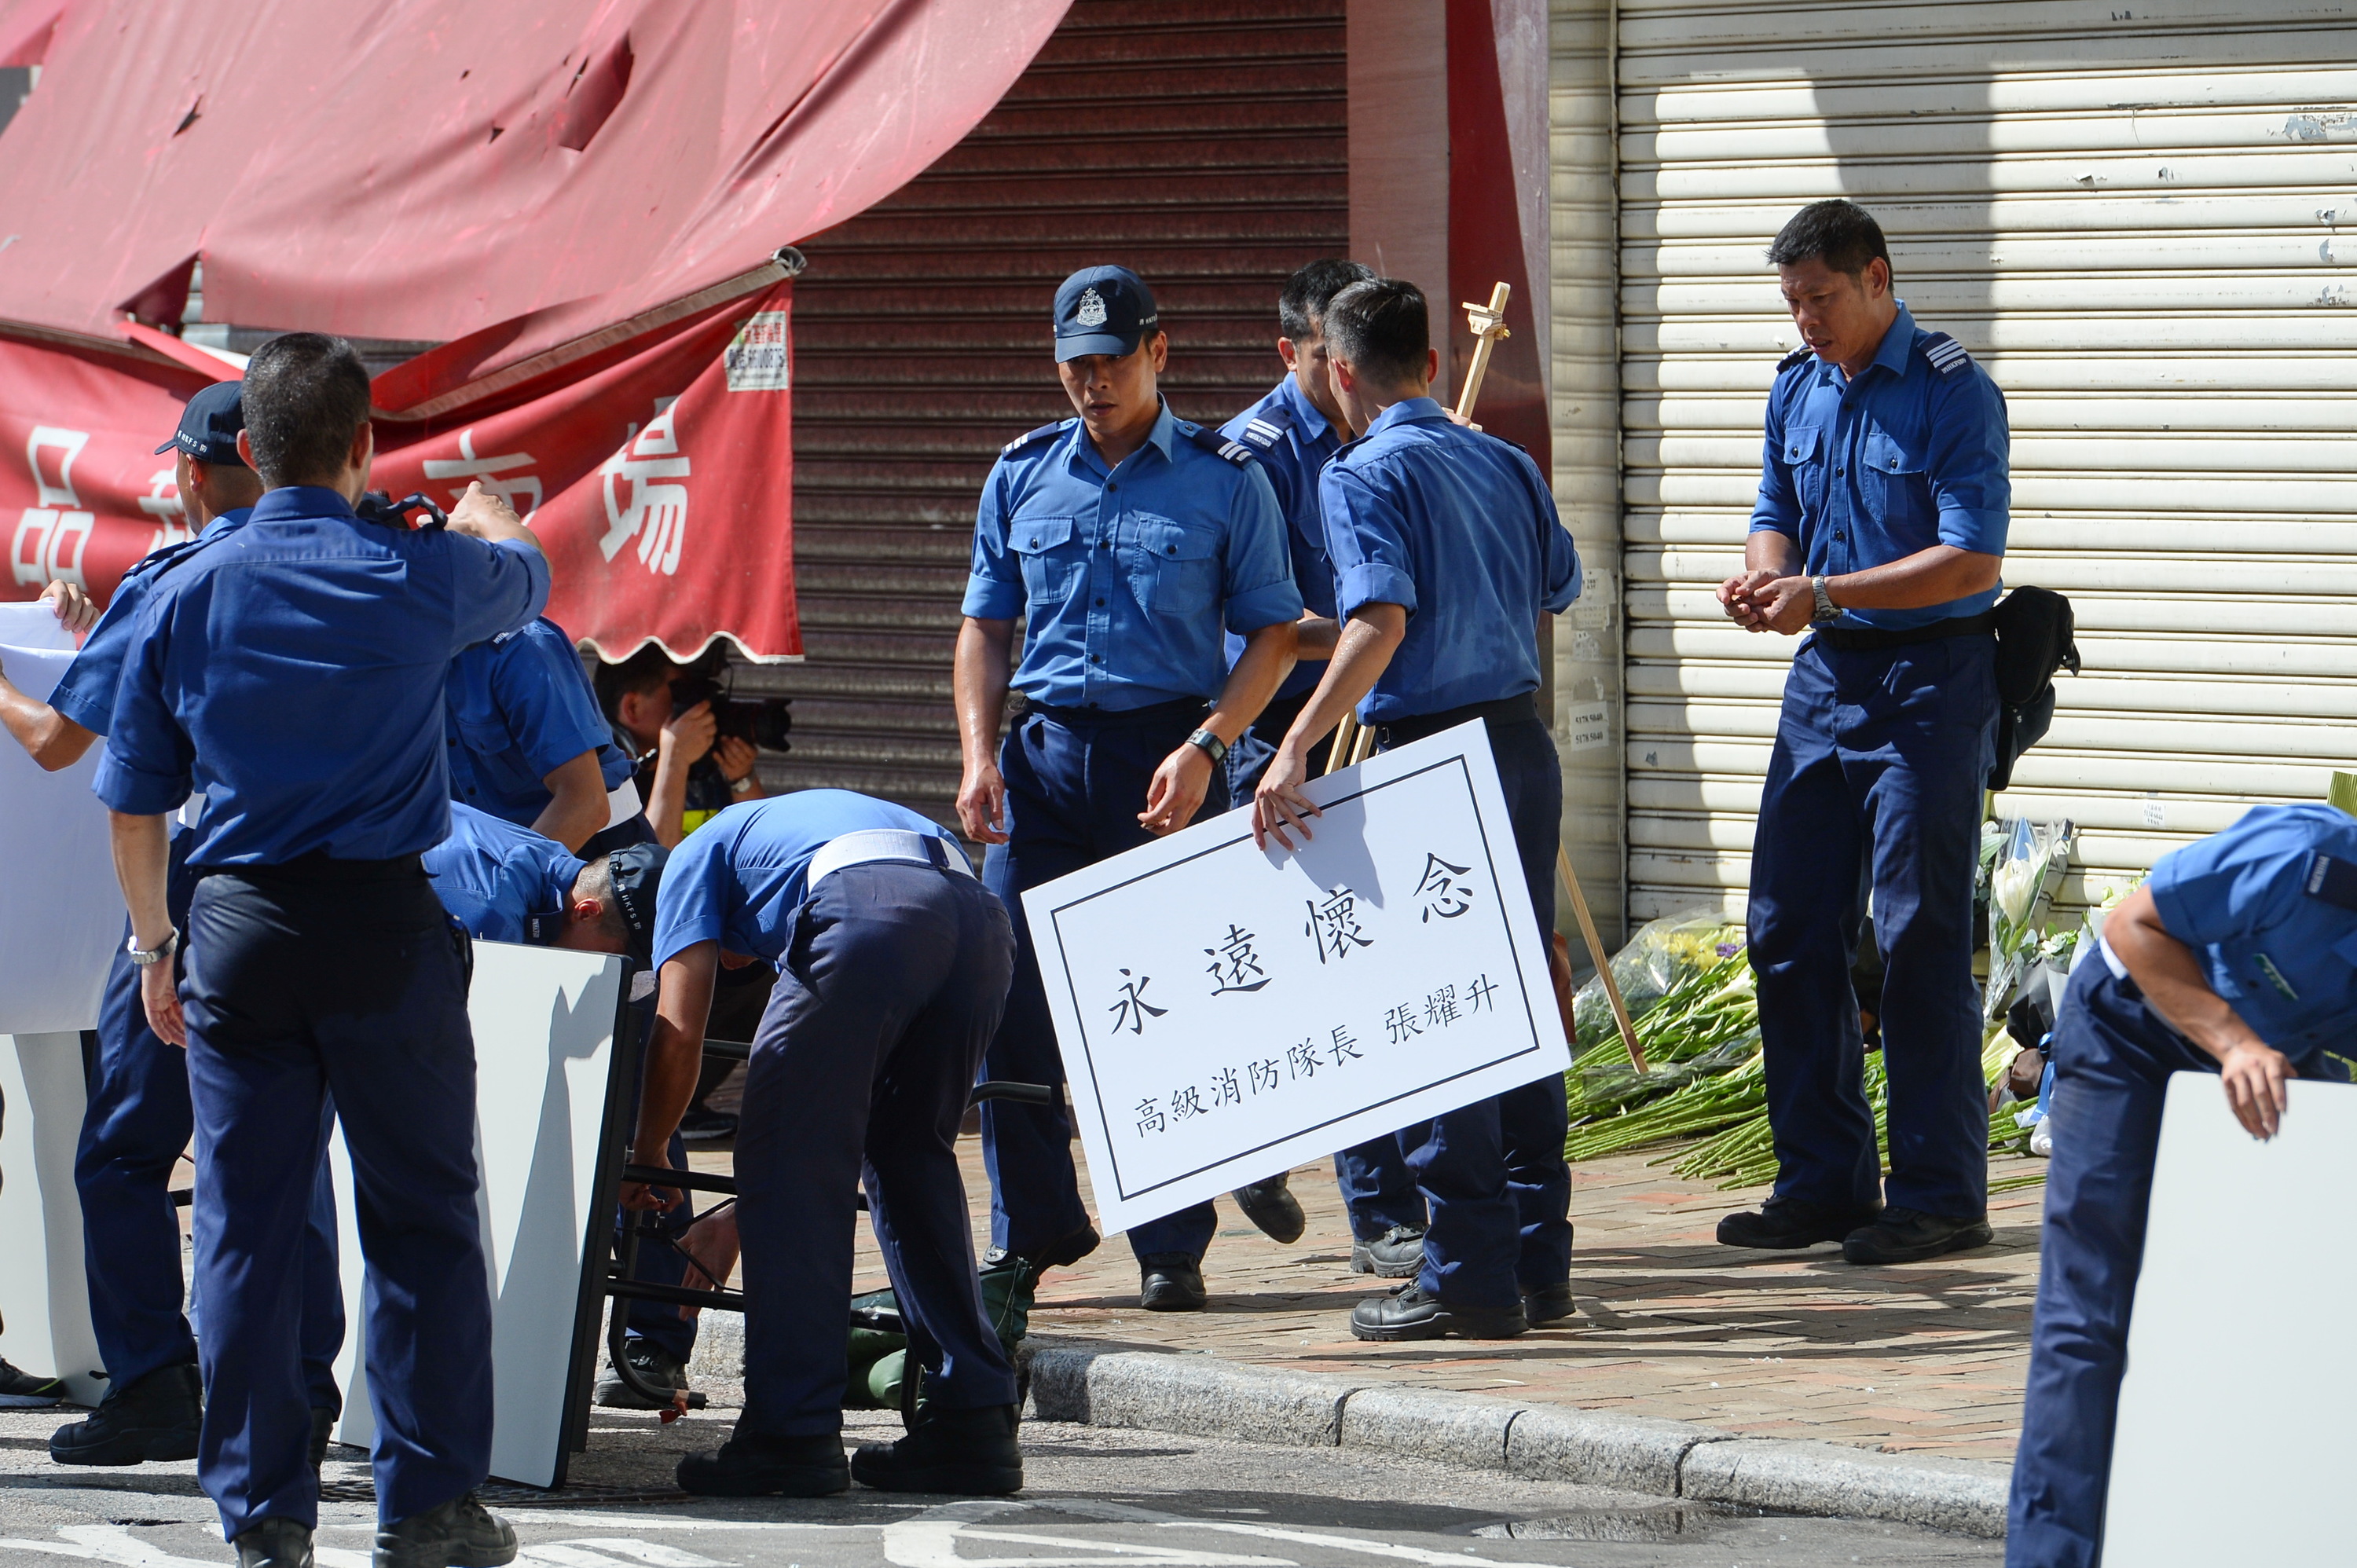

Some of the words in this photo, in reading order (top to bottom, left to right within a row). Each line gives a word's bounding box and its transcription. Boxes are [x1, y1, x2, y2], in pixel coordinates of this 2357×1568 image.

[622, 895, 637, 919] HKFS
[1109, 853, 1473, 1035] 永遠懷念
[1135, 1024, 1364, 1138] 高級消防隊長
[1384, 974, 1498, 1045] 張耀升
